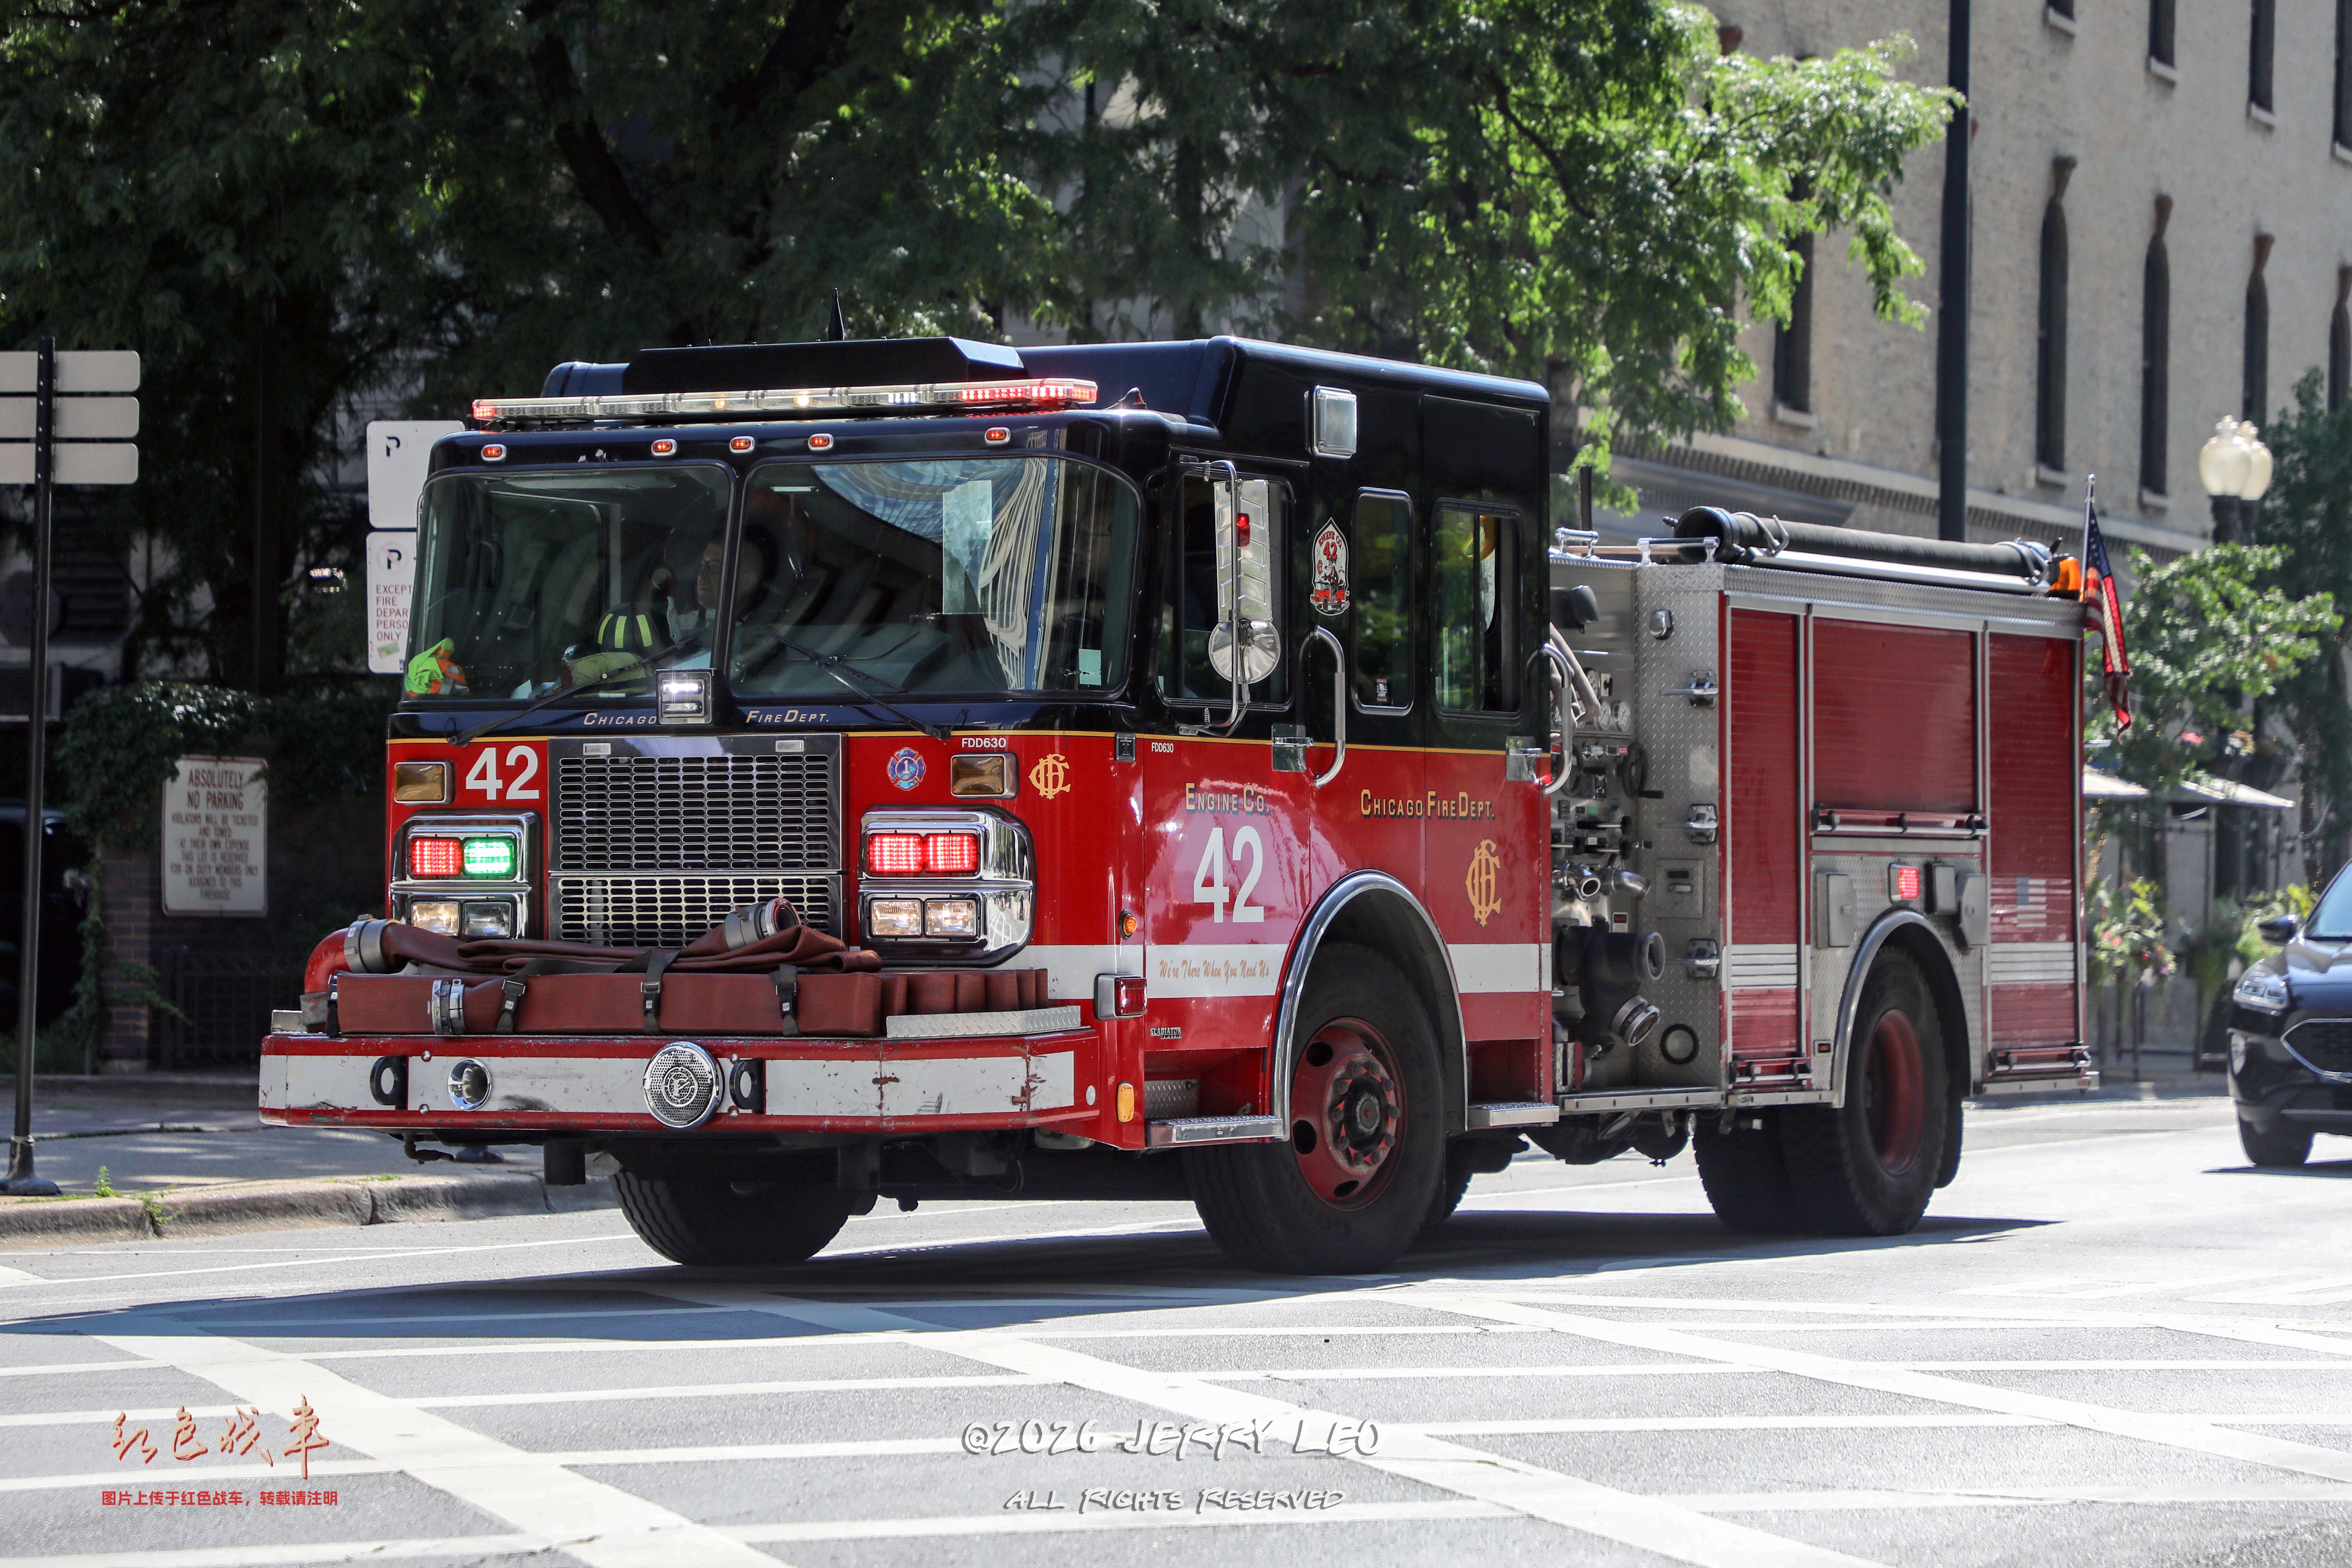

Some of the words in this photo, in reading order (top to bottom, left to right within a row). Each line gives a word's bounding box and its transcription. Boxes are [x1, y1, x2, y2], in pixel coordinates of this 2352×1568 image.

[1318, 531, 1335, 547] ENGINE
[1323, 541, 1337, 560] 42
[376, 584, 412, 594] EXCEPT
[377, 596, 397, 606] FIRE
[377, 608, 410, 618] DEPAR
[377, 631, 401, 641] ONLY
[583, 713, 657, 725] CHICAGO
[962, 738, 1006, 748] FDD630
[1151, 742, 1174, 753] FDD630
[188, 769, 244, 789] ABSOLUTELY
[466, 745, 539, 800] 42
[187, 791, 200, 809] NO
[207, 791, 244, 811] PARKING
[1185, 783, 1239, 811] ENGINE
[1243, 785, 1271, 815] CO.
[1360, 789, 1423, 818] CHICAGO
[172, 812, 201, 824] VIOLATORS
[206, 813, 217, 825] WILL
[222, 814, 229, 825] BE
[233, 815, 258, 826] TICKETED
[199, 827, 210, 837] AND
[214, 827, 232, 837] TOWED
[180, 838, 186, 849] AT
[190, 838, 206, 849] THEIR
[209, 839, 221, 850] OWN
[225, 839, 249, 851] EXPENSE
[182, 851, 194, 861] THIS
[212, 852, 217, 862] IS
[220, 852, 249, 864] RESERVED
[170, 863, 181, 874] FOR
[185, 863, 193, 874] ON
[197, 863, 212, 874] DUTY
[215, 864, 242, 875] MEMBERS
[245, 865, 258, 876] ONLY
[1194, 826, 1264, 923] 42
[189, 876, 216, 887] ASSIGNED
[219, 877, 226, 887] TO
[230, 877, 242, 888] THIS
[200, 888, 231, 900] FIREHOUSE
[1159, 960, 1179, 978] We're
[1182, 960, 1200, 979] There
[1203, 960, 1221, 978] When
[1224, 960, 1237, 986] You
[1240, 959, 1257, 979] Need
[1259, 959, 1269, 977] Us
[1150, 1027, 1181, 1035] GLADIATOR
